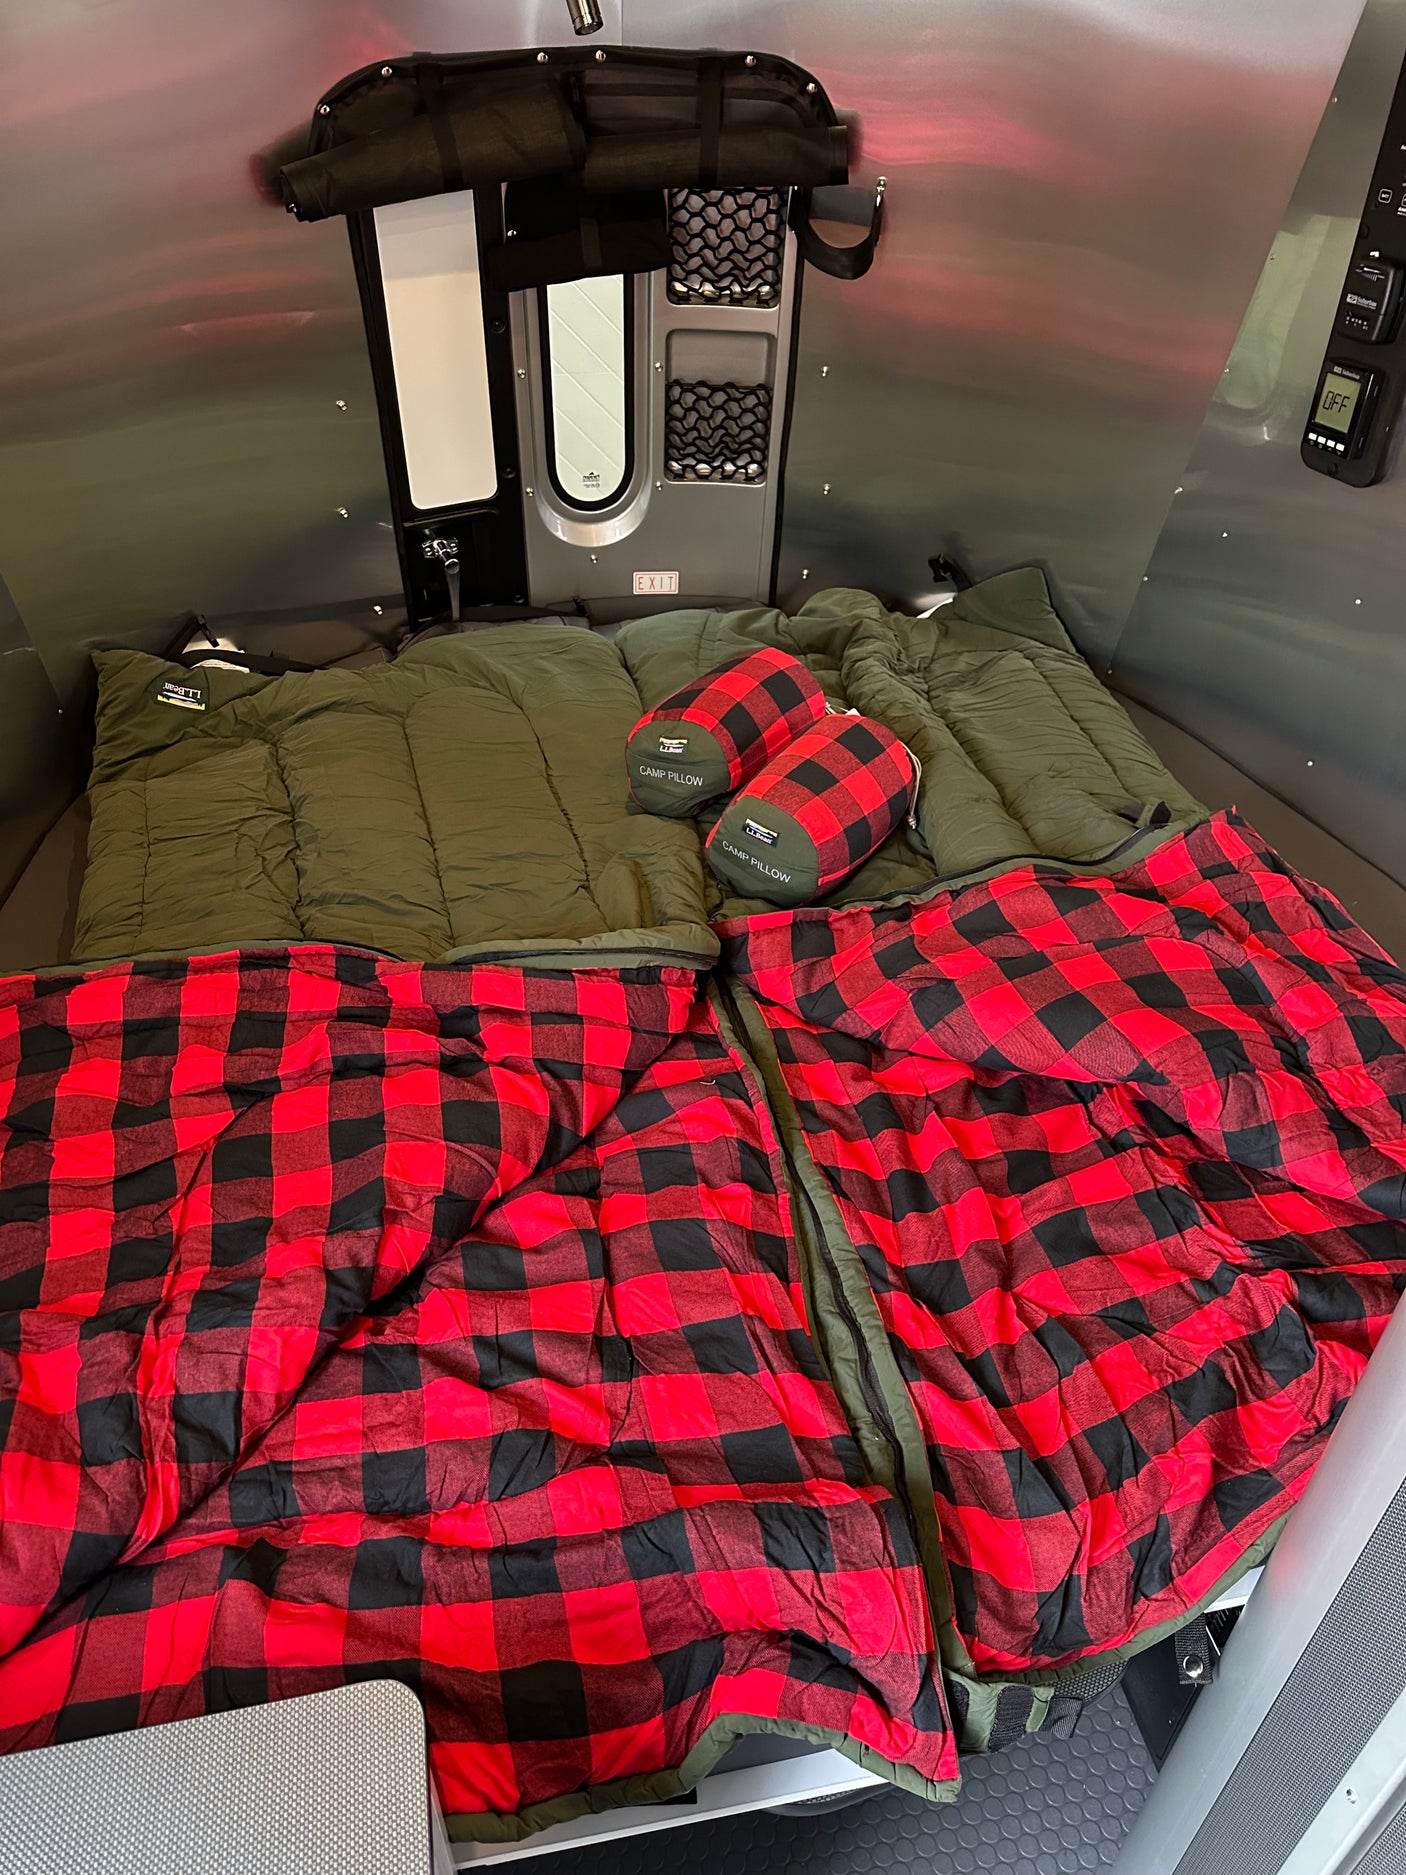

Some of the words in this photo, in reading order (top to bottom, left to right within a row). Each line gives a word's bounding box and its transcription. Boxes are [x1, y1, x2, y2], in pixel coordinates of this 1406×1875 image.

[1323, 390, 1350, 413] OFF
[638, 576, 674, 590] EXIT
[640, 765, 666, 779] CAMP
[668, 771, 703, 787] PILLOW
[722, 840, 749, 861] CAMP
[750, 857, 791, 884] PILLOW
